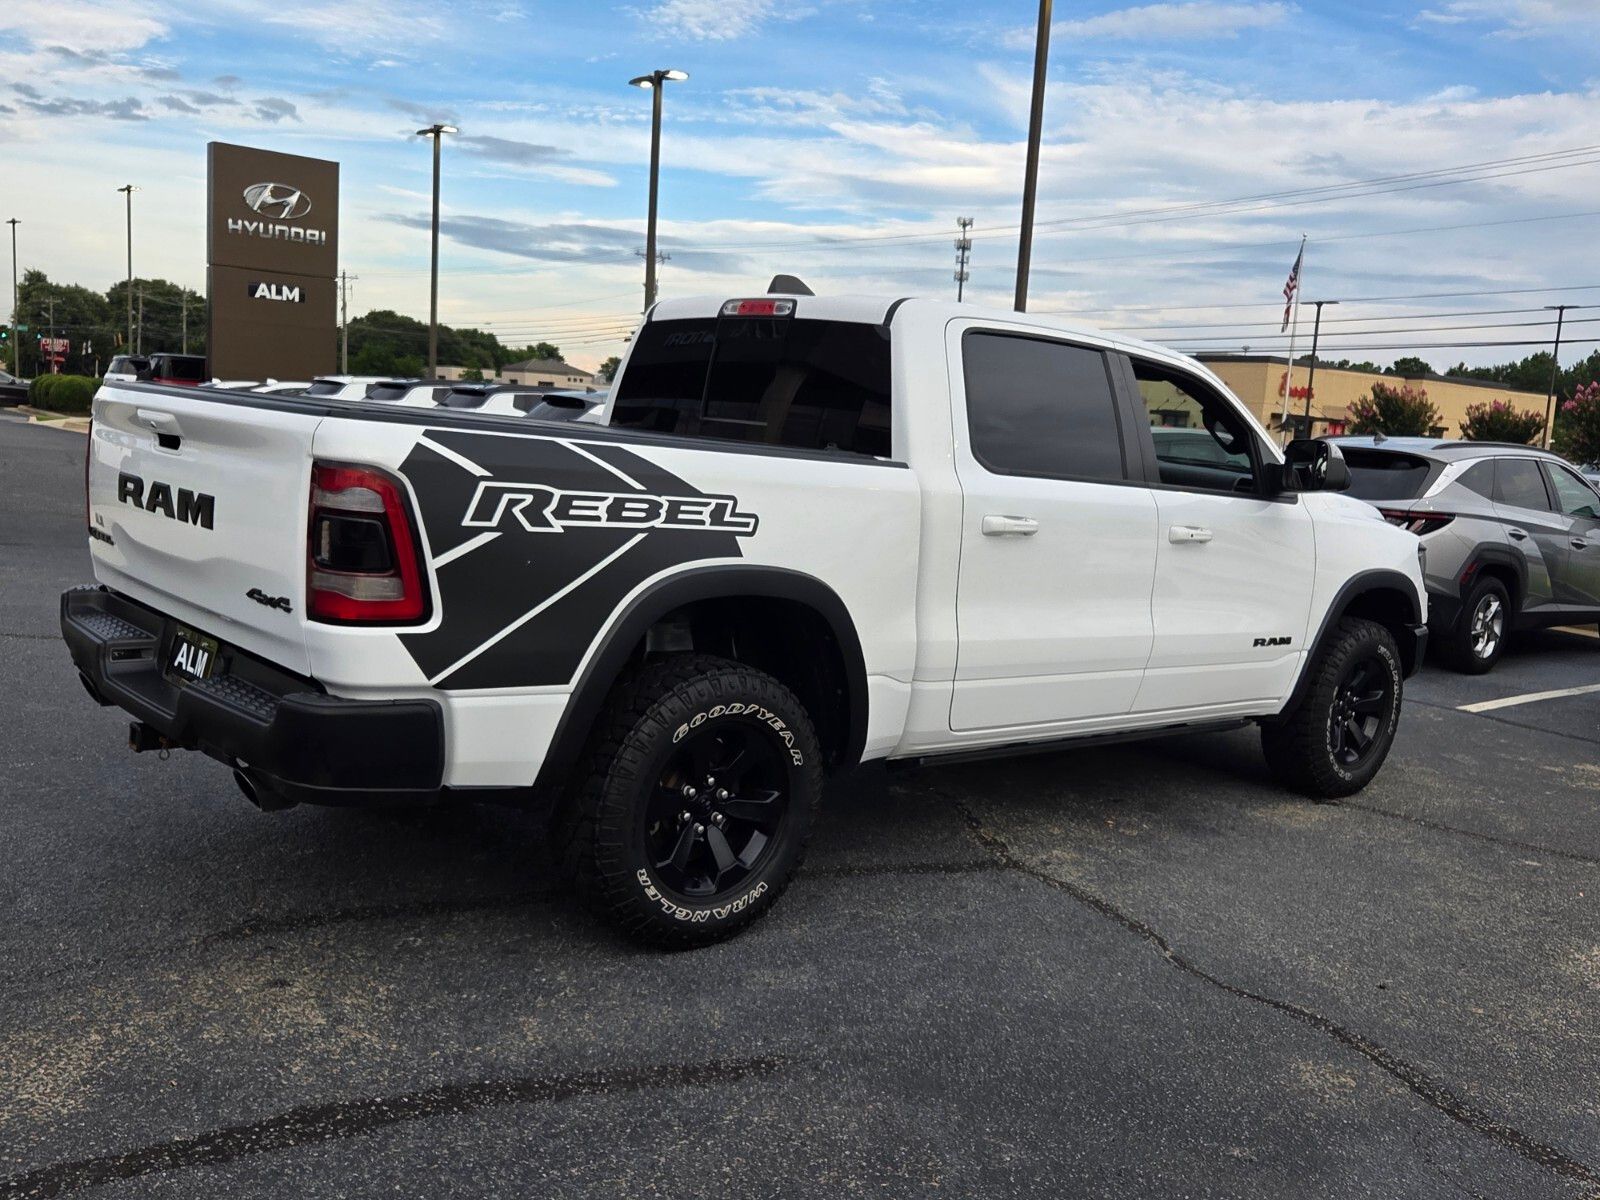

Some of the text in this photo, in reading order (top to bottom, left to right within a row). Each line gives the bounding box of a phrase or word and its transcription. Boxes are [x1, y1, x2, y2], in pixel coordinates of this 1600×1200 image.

[228, 217, 326, 245] HYUNDAI
[254, 282, 300, 303] ALM
[118, 471, 216, 531] RAM
[461, 480, 760, 536] REBEL
[173, 642, 209, 679] ALM
[1253, 636, 1292, 647] RAM
[672, 703, 804, 766] GOODYEAR
[636, 868, 769, 922] WRANGLER
